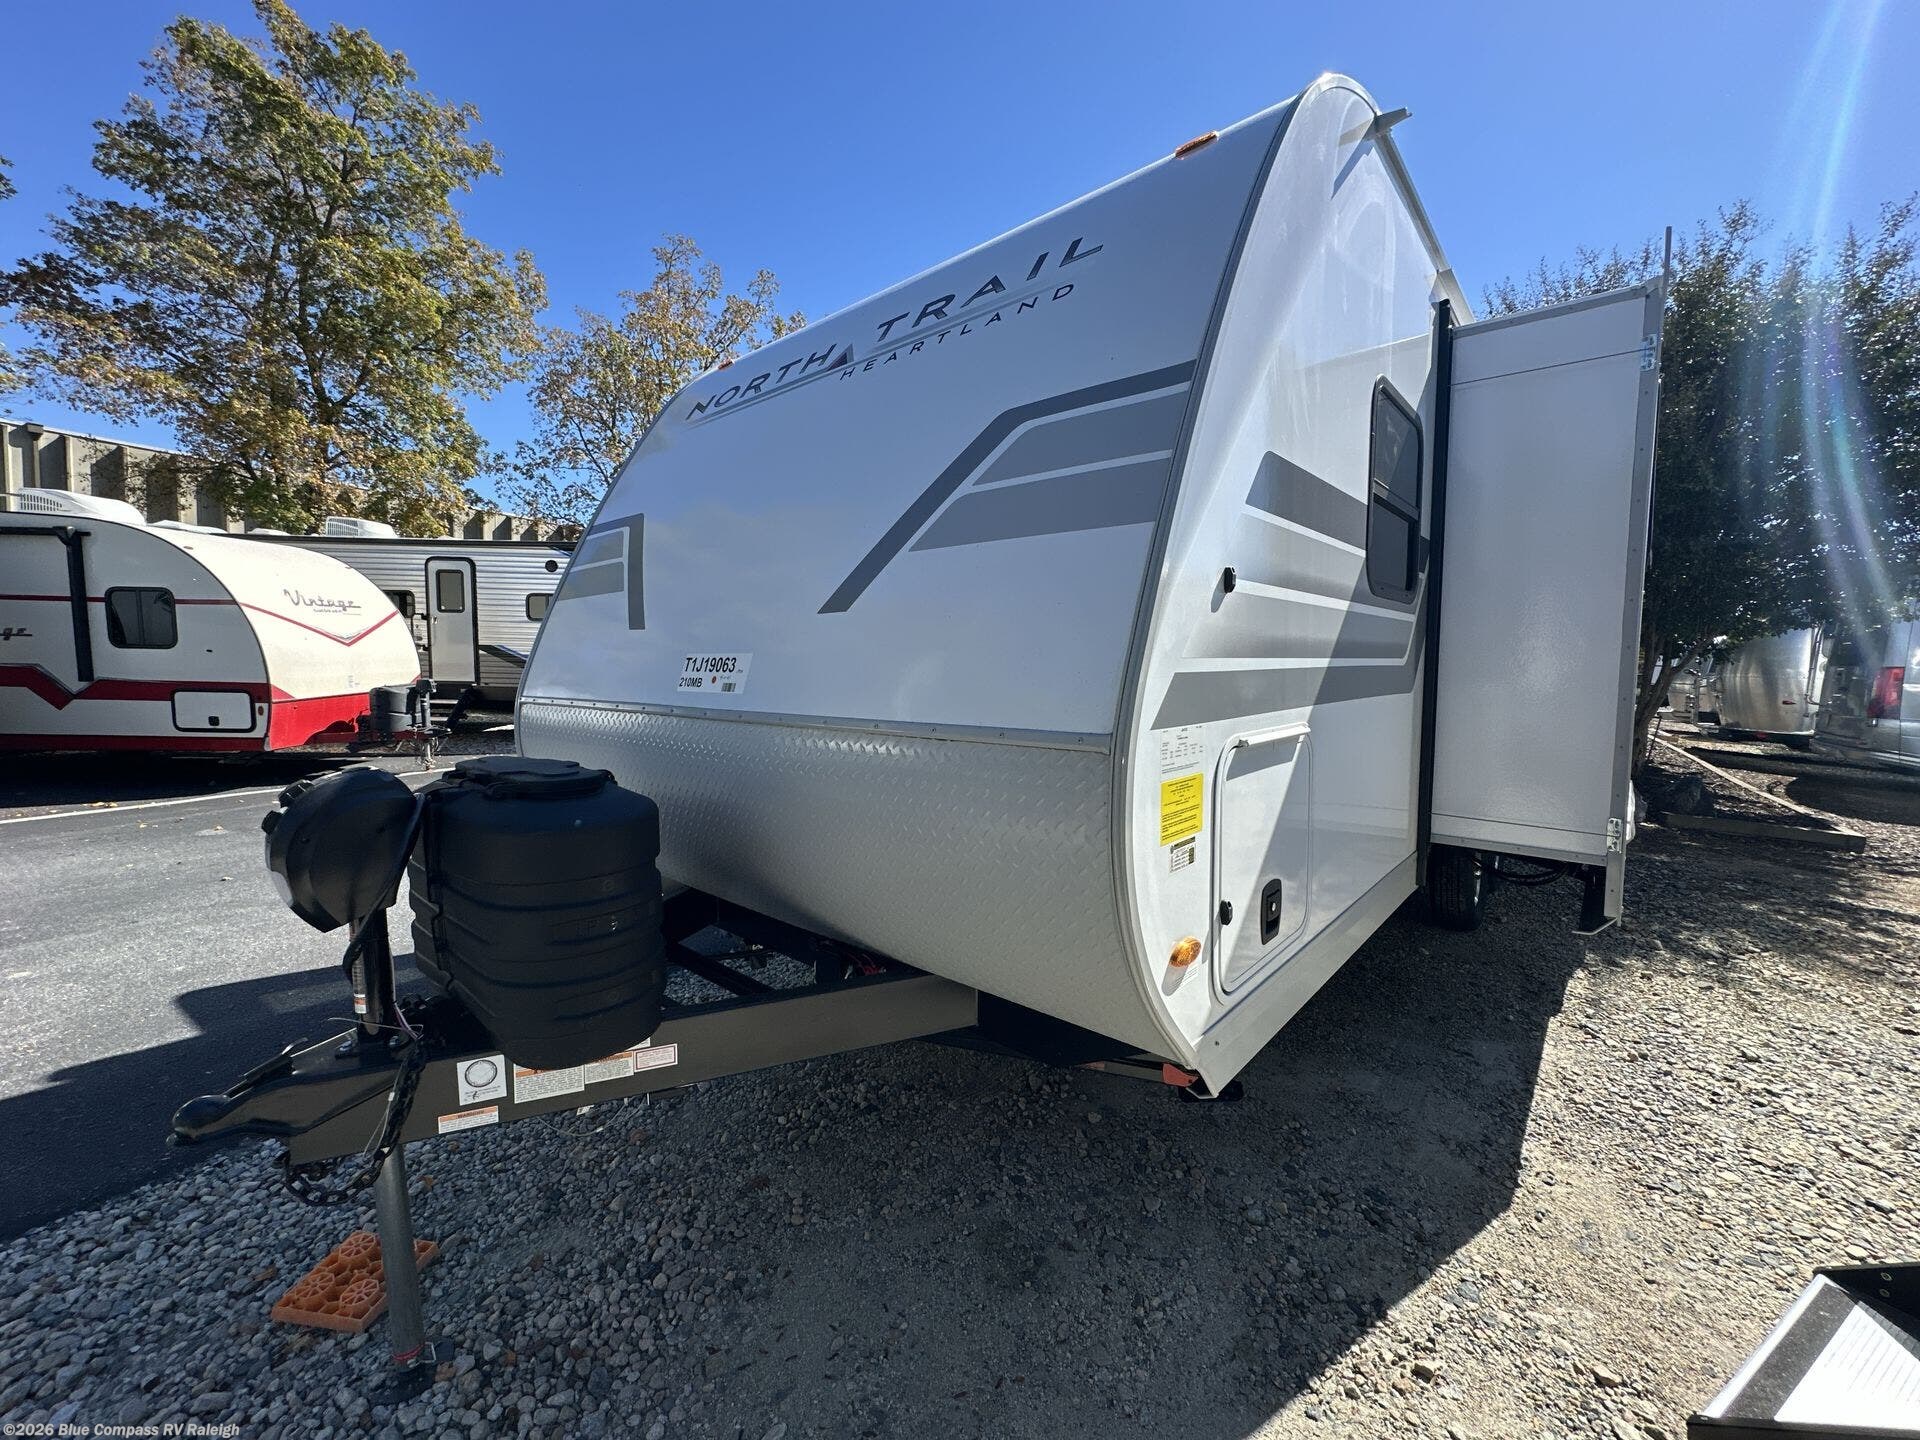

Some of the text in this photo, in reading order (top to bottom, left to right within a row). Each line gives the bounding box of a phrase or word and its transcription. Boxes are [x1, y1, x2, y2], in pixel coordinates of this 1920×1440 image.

[686, 236, 1104, 421] NORTH TRAIL
[840, 283, 1075, 381] HEARTLAND
[283, 588, 362, 612] Vintage
[685, 657, 736, 673] T1J19063
[679, 677, 703, 688] 210MB
